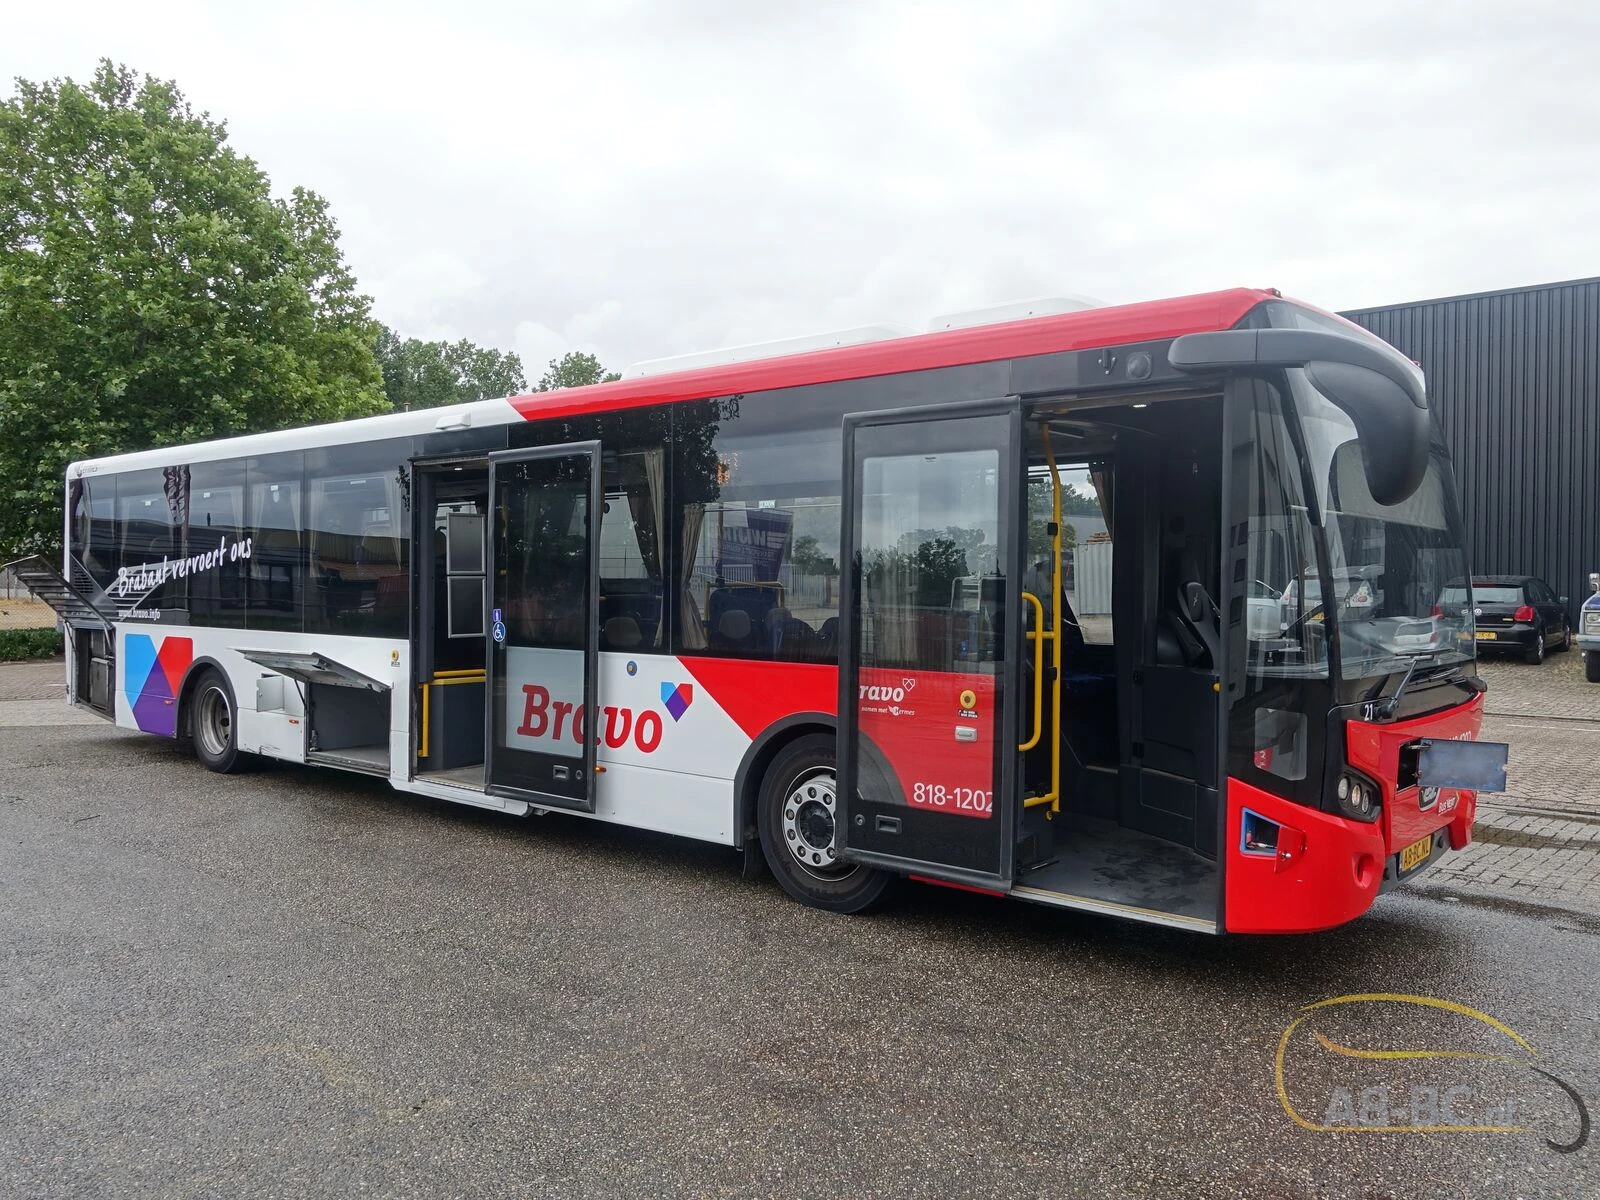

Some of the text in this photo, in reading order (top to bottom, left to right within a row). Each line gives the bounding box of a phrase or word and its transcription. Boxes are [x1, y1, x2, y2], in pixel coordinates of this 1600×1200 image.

[118, 535, 252, 597] Brabant vervoert ons
[860, 685, 904, 702] ravo
[1364, 704, 1373, 721] 21
[913, 782, 993, 813] 818-1202
